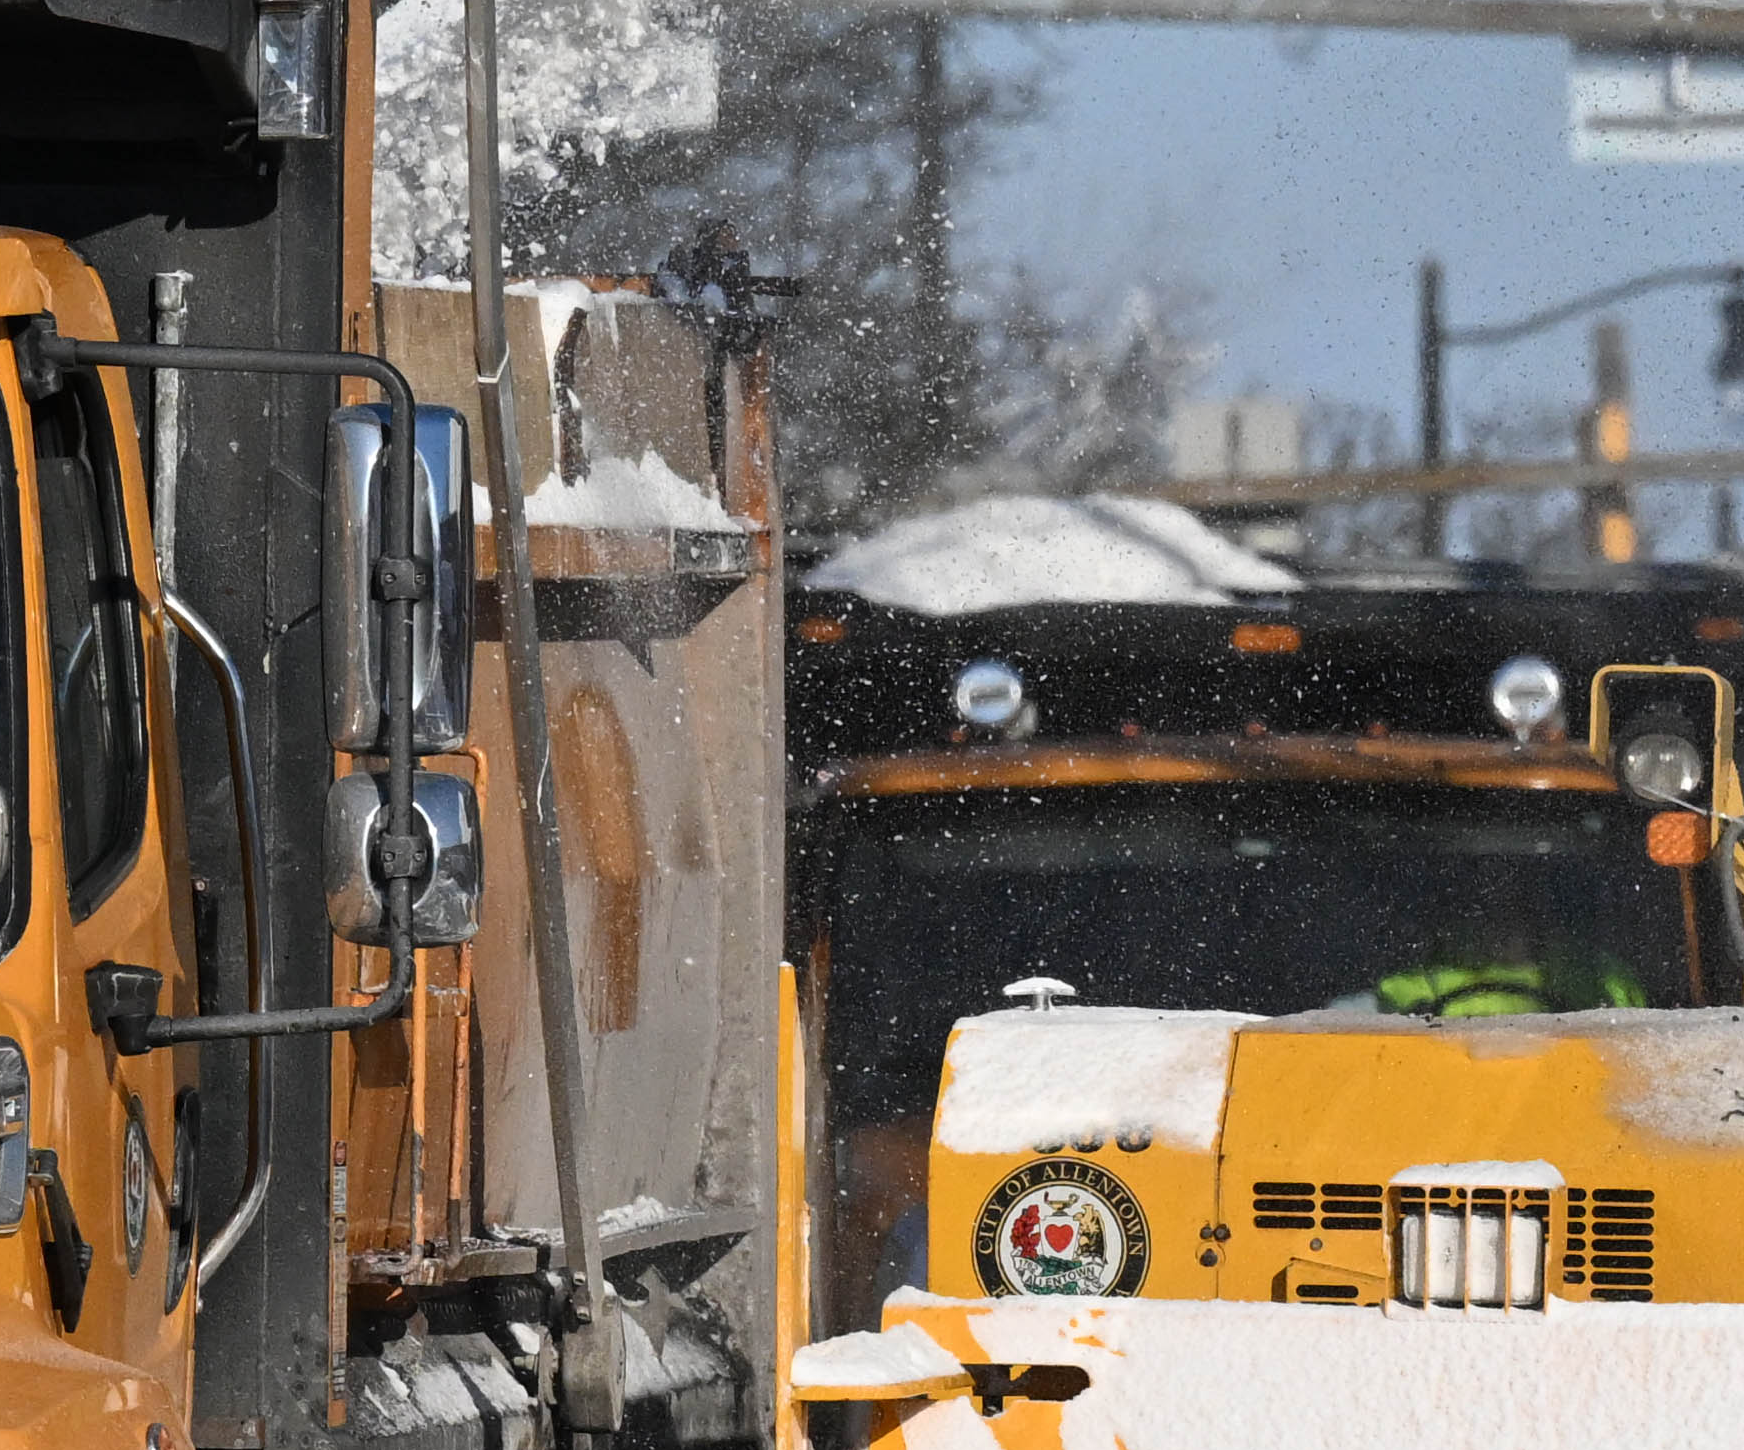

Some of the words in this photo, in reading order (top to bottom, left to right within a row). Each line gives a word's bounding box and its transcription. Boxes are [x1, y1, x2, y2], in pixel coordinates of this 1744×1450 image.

[978, 1198, 1006, 1255] CITY
[1006, 1170, 1032, 1197] OF
[1042, 1162, 1145, 1256] ALLENTOWN
